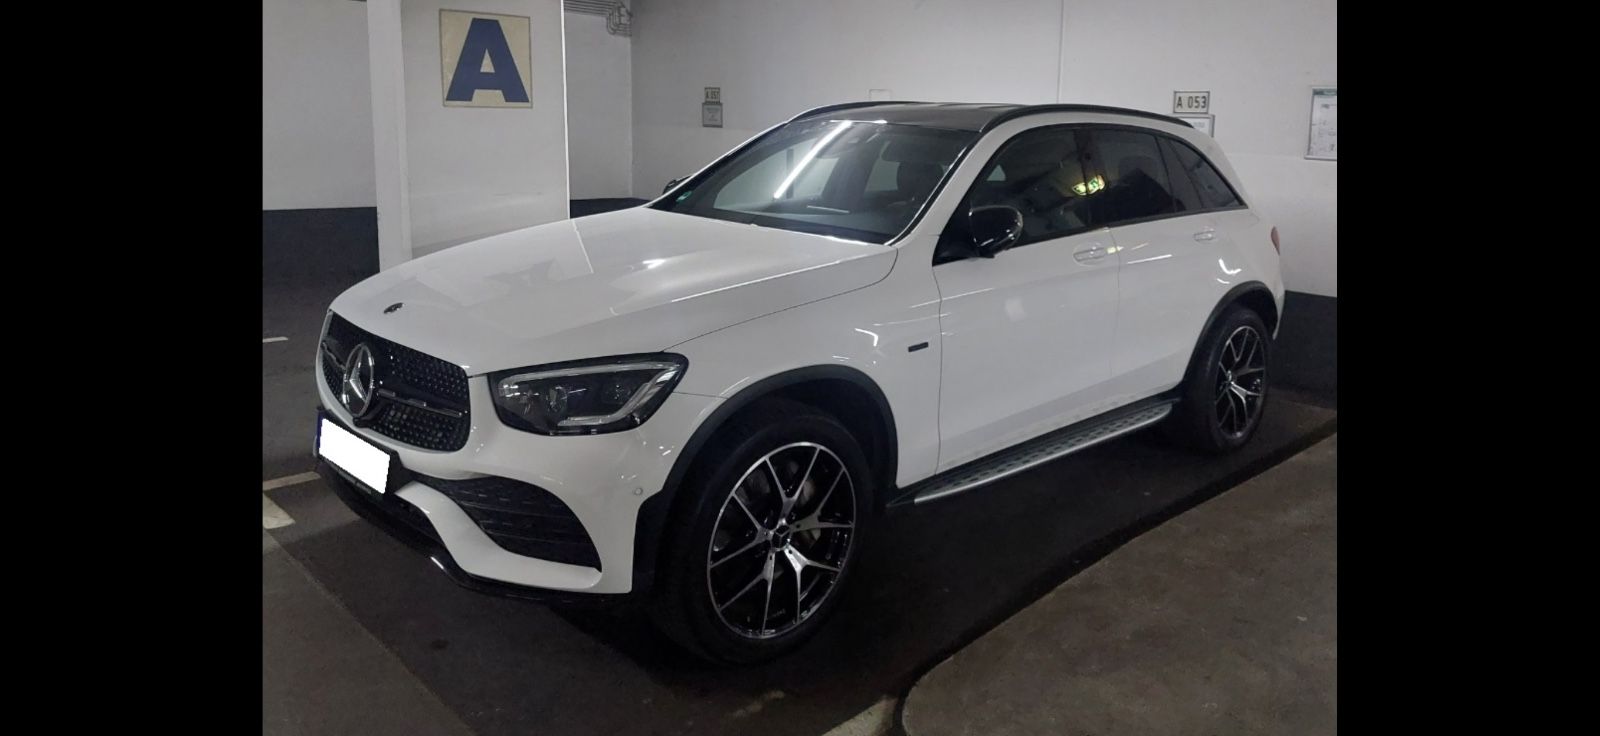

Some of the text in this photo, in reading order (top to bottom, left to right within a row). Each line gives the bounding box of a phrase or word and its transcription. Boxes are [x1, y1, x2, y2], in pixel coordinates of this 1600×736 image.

[445, 17, 530, 103] A
[1176, 95, 1207, 109] A 053
